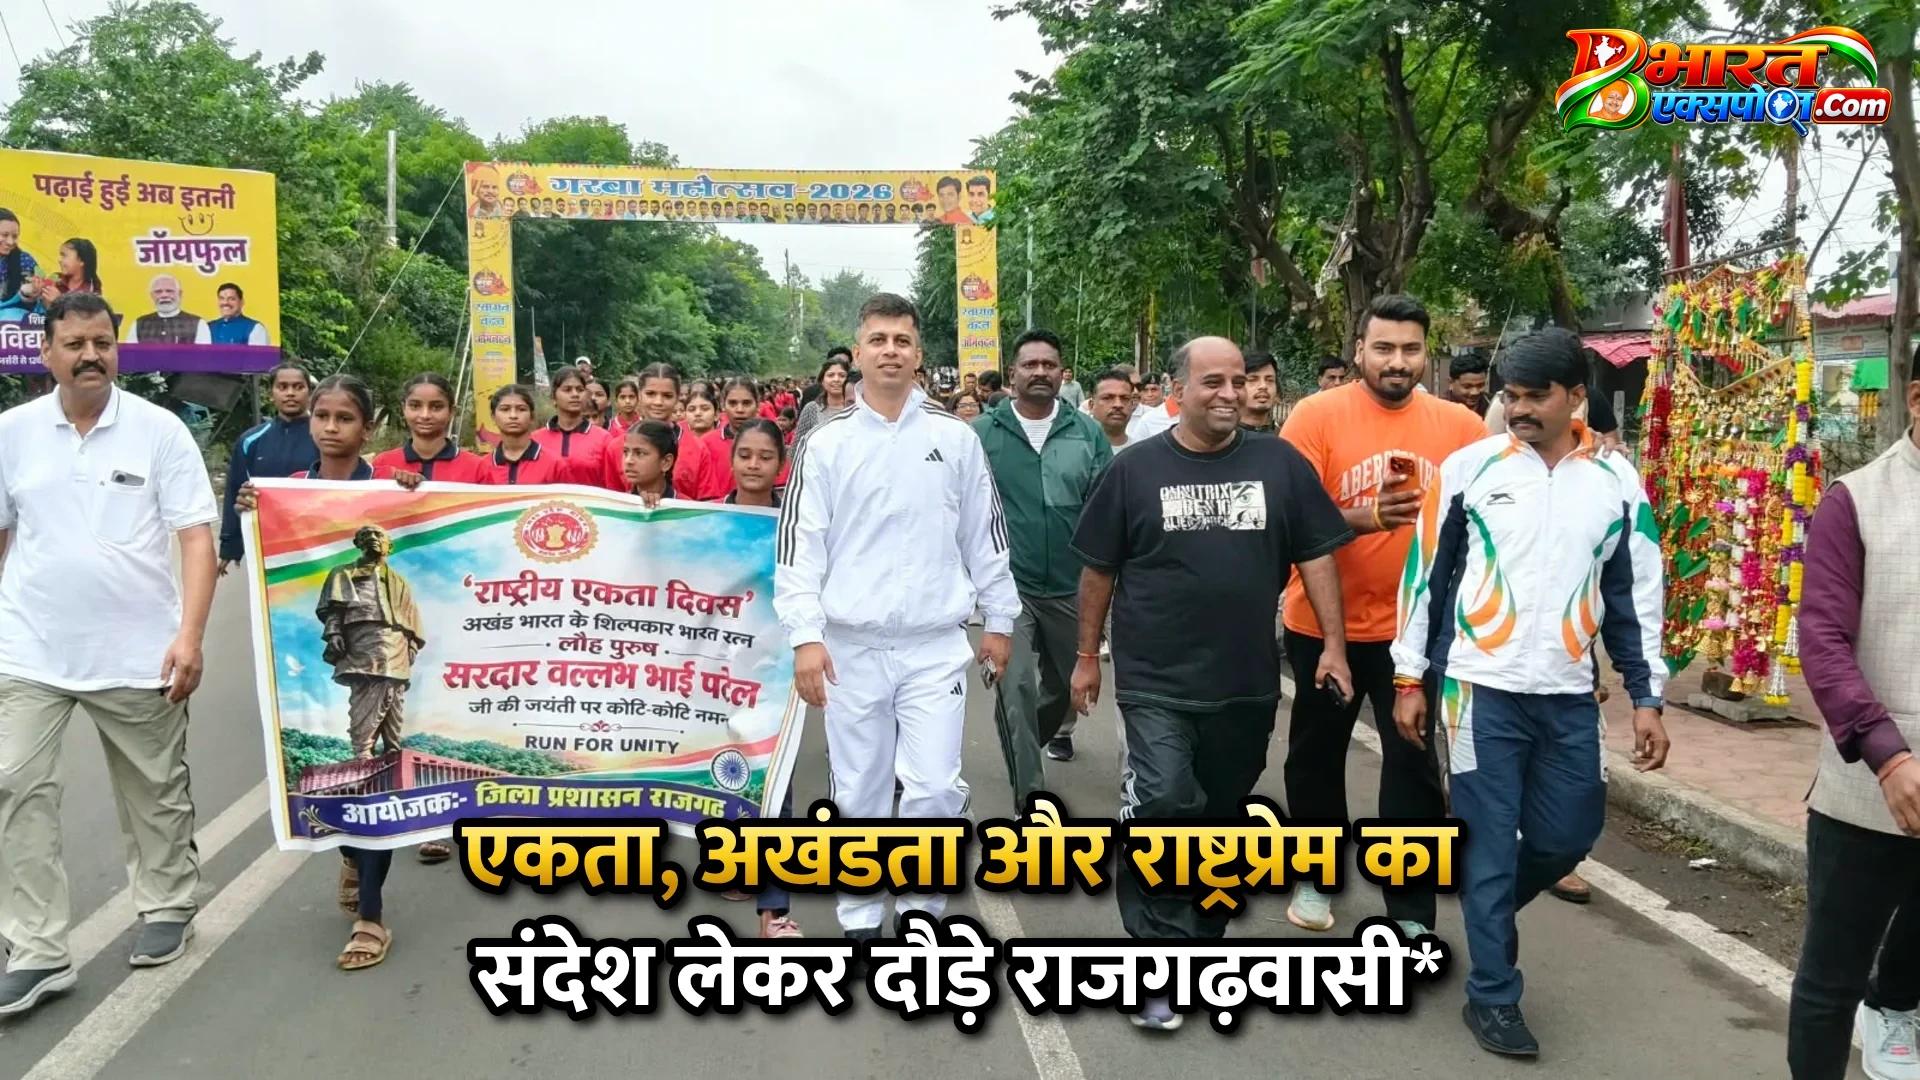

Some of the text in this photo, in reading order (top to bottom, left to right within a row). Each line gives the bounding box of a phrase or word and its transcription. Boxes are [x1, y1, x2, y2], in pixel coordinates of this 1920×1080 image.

[33, 171, 235, 211] पढ़ाई हुई अब इतनी
[549, 176, 642, 195] गरबा
[136, 231, 247, 273] जॉयफुल
[571, 578, 658, 606] एकता
[463, 610, 755, 649] अखंड भारत के शिल्पकार भारत रत्न
[558, 631, 659, 660] लौह पुरुष
[443, 660, 541, 689] सरदार
[548, 660, 638, 689] वल्लभ
[645, 660, 696, 698] भाई
[469, 697, 491, 715] जी
[497, 699, 520, 714] की
[525, 695, 575, 714] जयंती
[581, 701, 601, 715] पर
[607, 697, 690, 722] कोटि-कोटि
[525, 735, 680, 755] RUN FOR UNITY
[475, 780, 541, 807] जिला
[548, 785, 643, 809] प्रशासन
